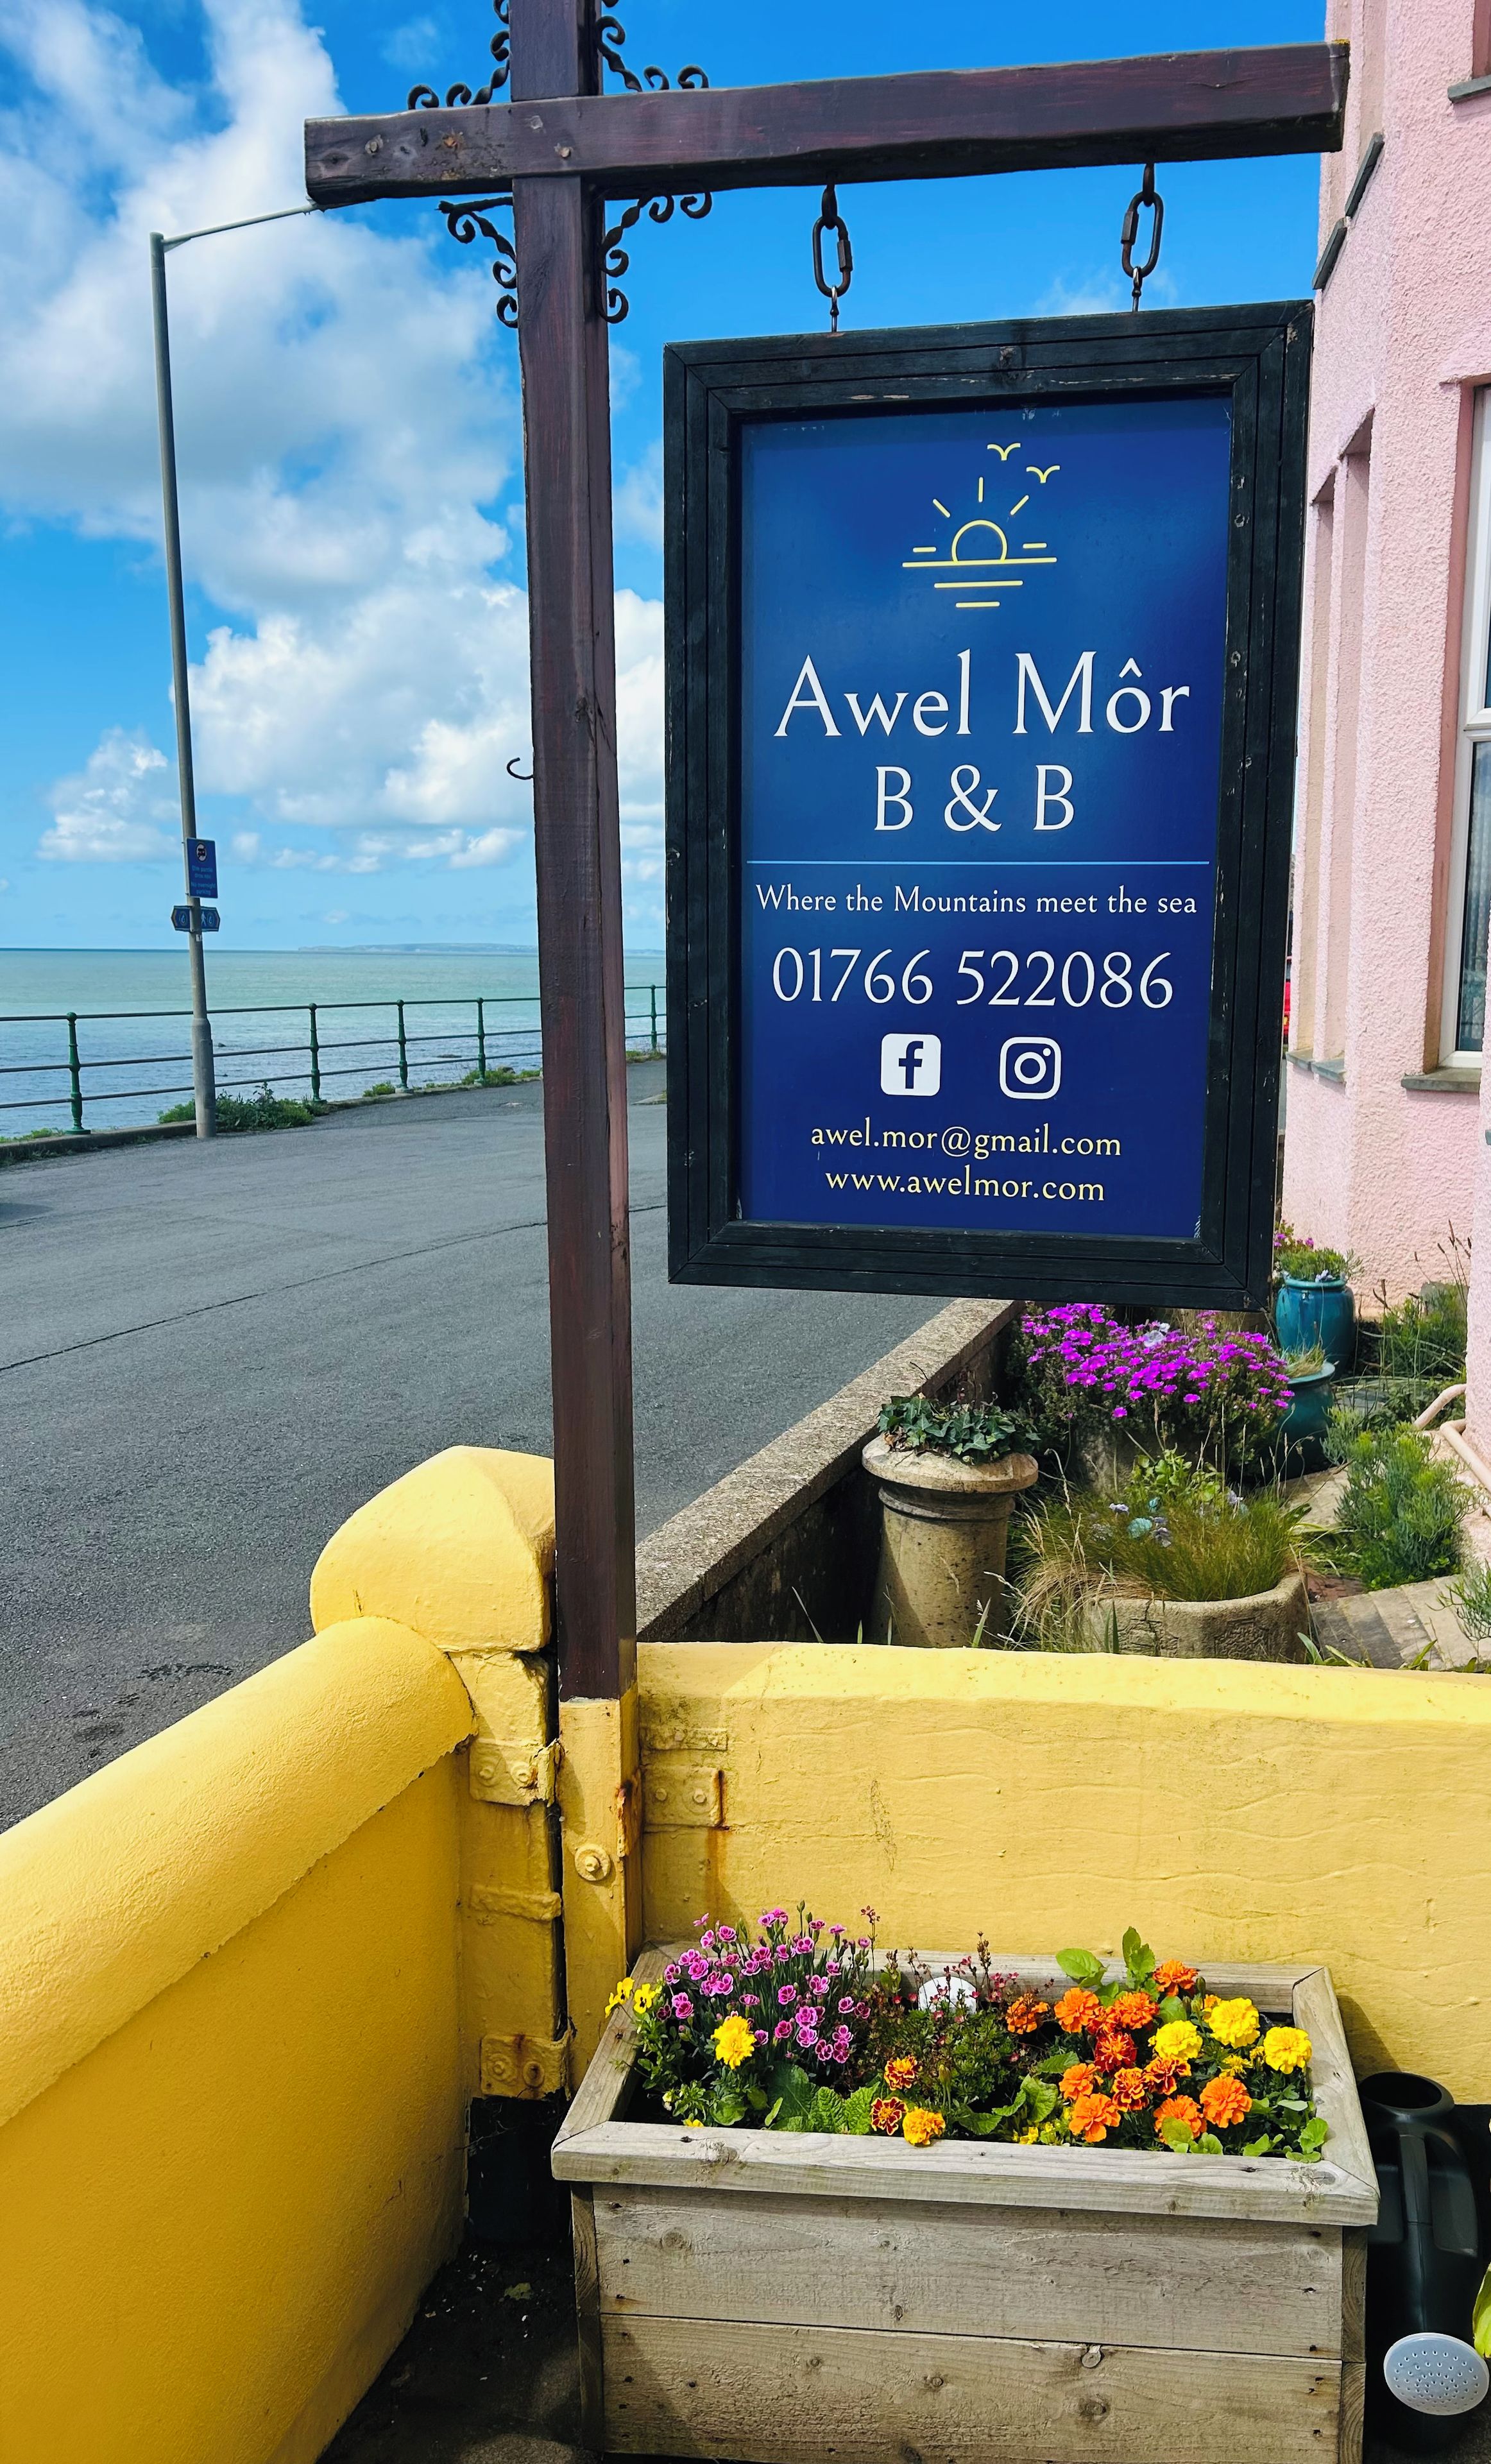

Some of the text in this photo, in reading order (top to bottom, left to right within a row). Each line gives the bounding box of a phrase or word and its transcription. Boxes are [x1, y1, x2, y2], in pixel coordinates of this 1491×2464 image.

[774, 649, 1189, 737] Awel Môr
[874, 764, 1075, 832] B & B
[756, 884, 1197, 914] Where the Mountains meet the sea
[772, 946, 1173, 1009] 01766 522086
[811, 1117, 1121, 1159] awel.mor@gmail.com
[825, 1165, 1105, 1201] www.awelmor.com
